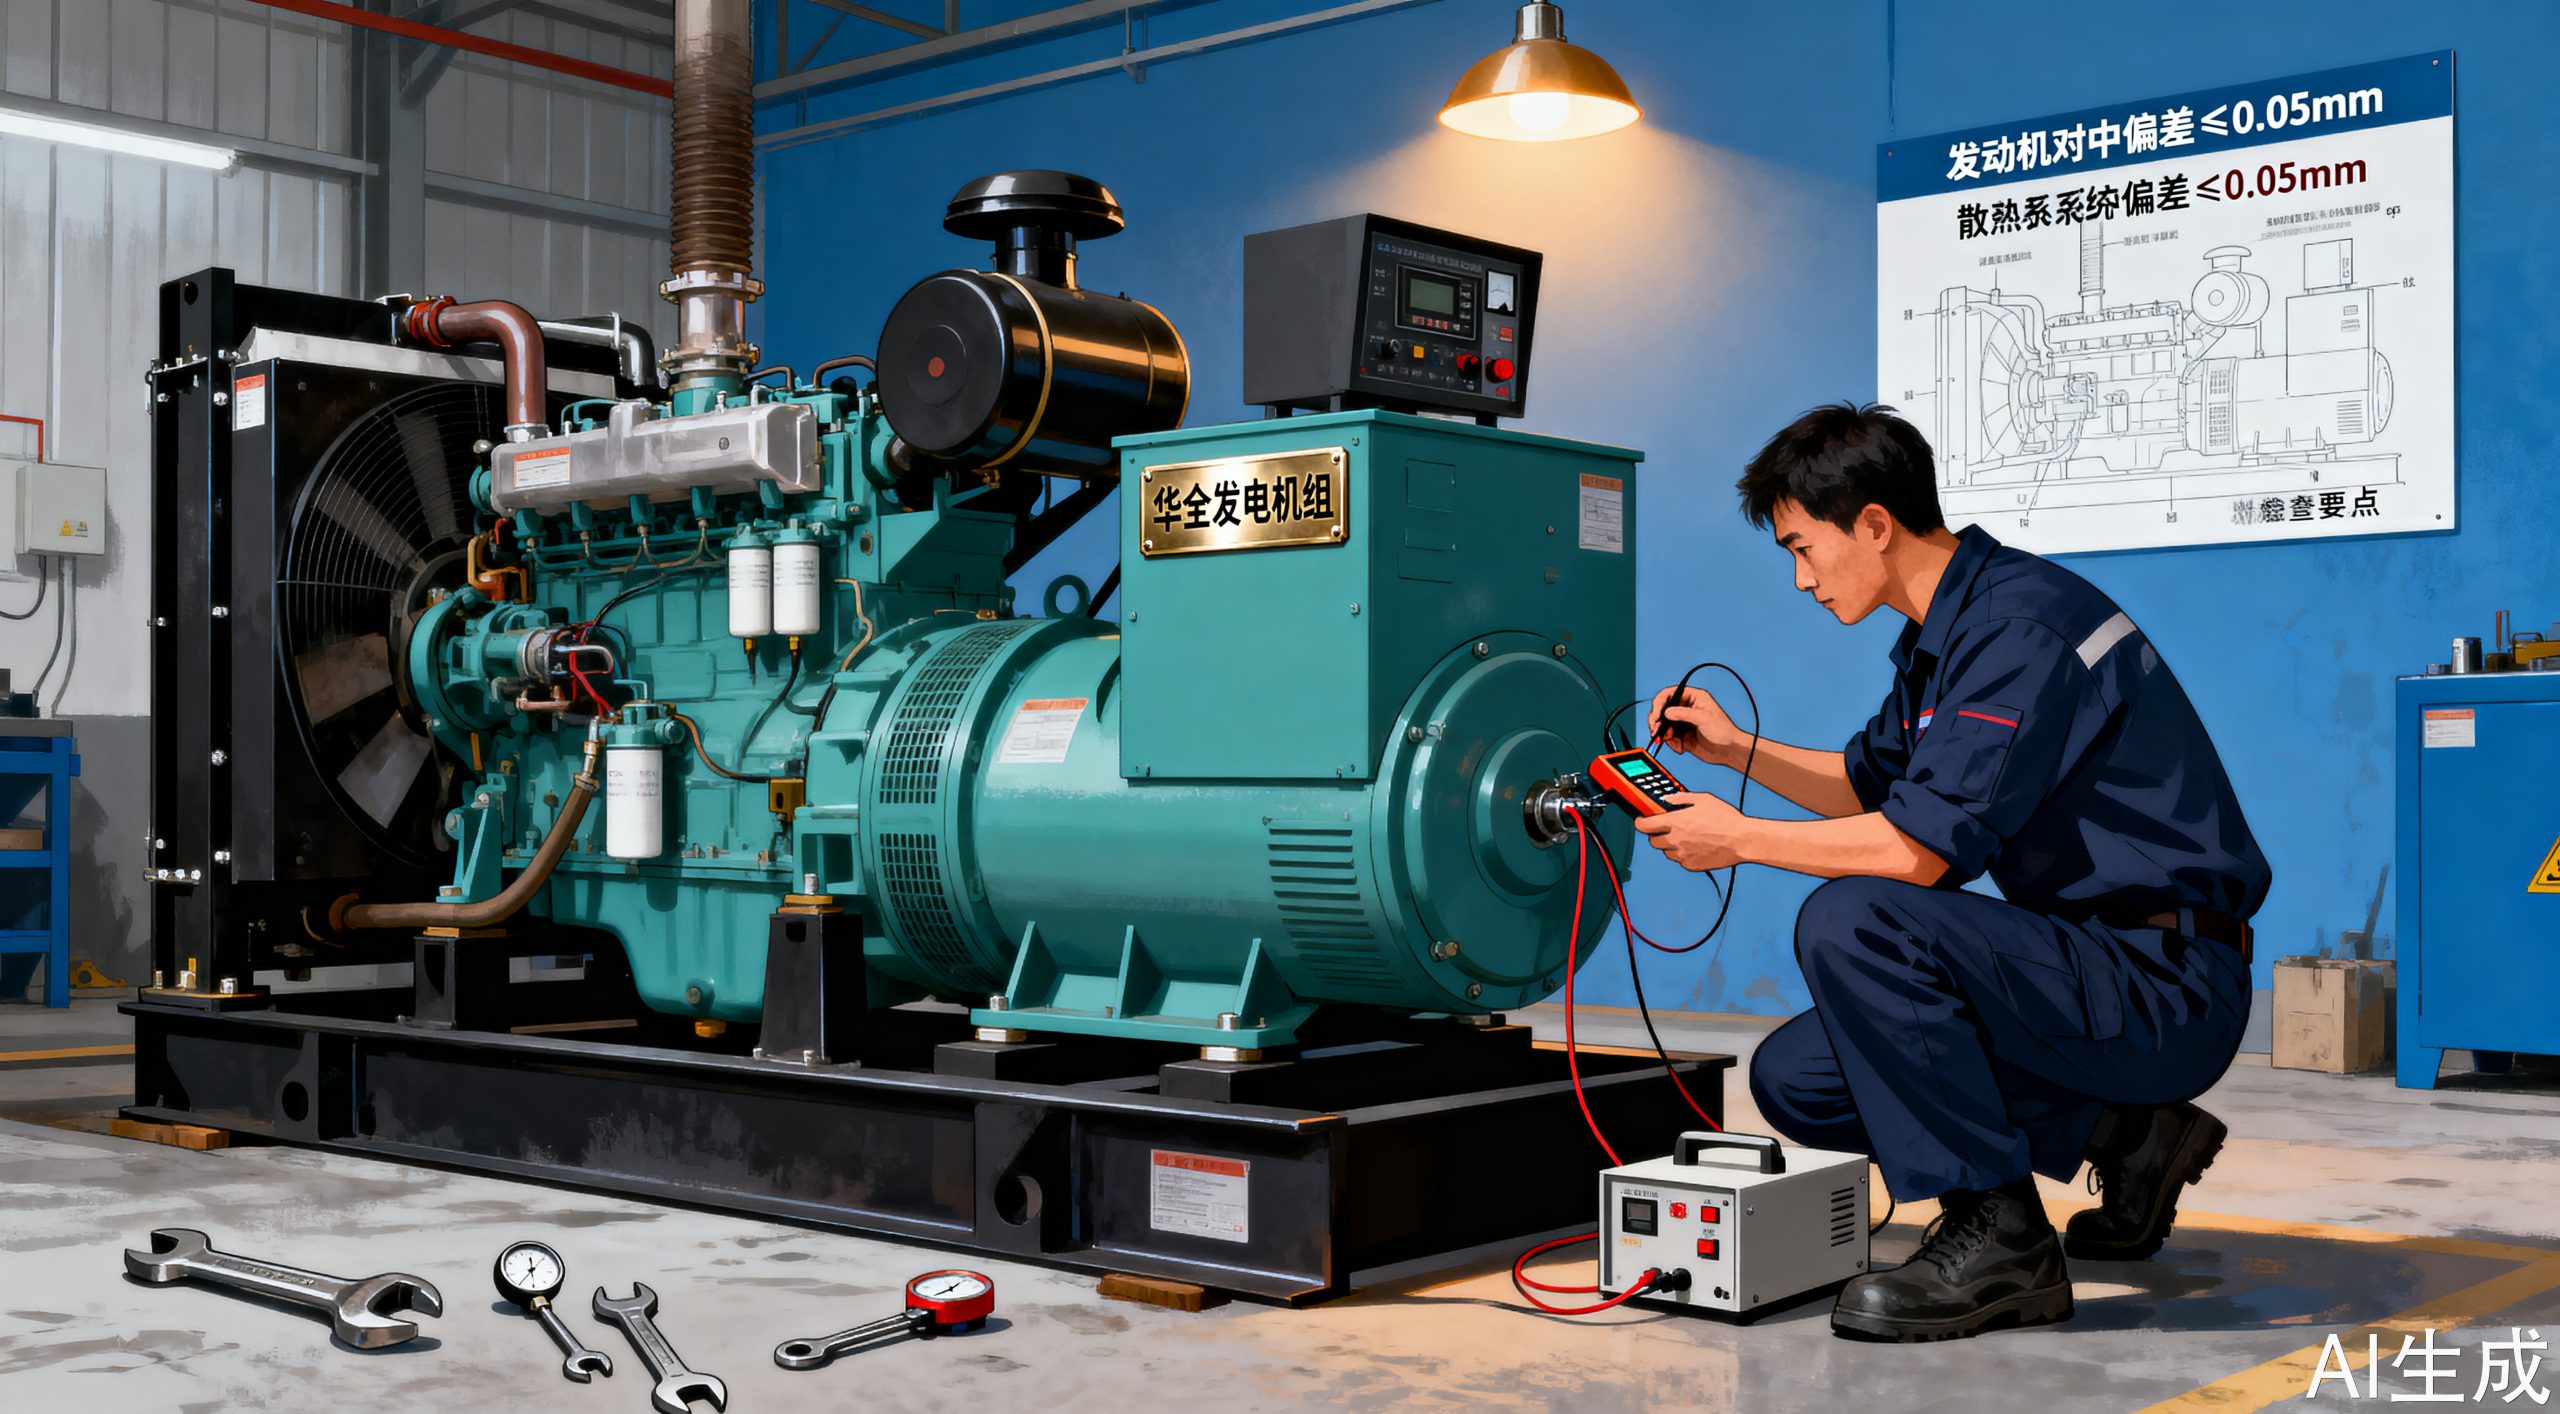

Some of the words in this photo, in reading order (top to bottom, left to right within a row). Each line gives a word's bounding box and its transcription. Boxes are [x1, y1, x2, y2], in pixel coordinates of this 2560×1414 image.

[1946, 87, 2384, 181] 发动机对中偏差≤0.05mm
[1153, 473, 1334, 532] 华全发电机组
